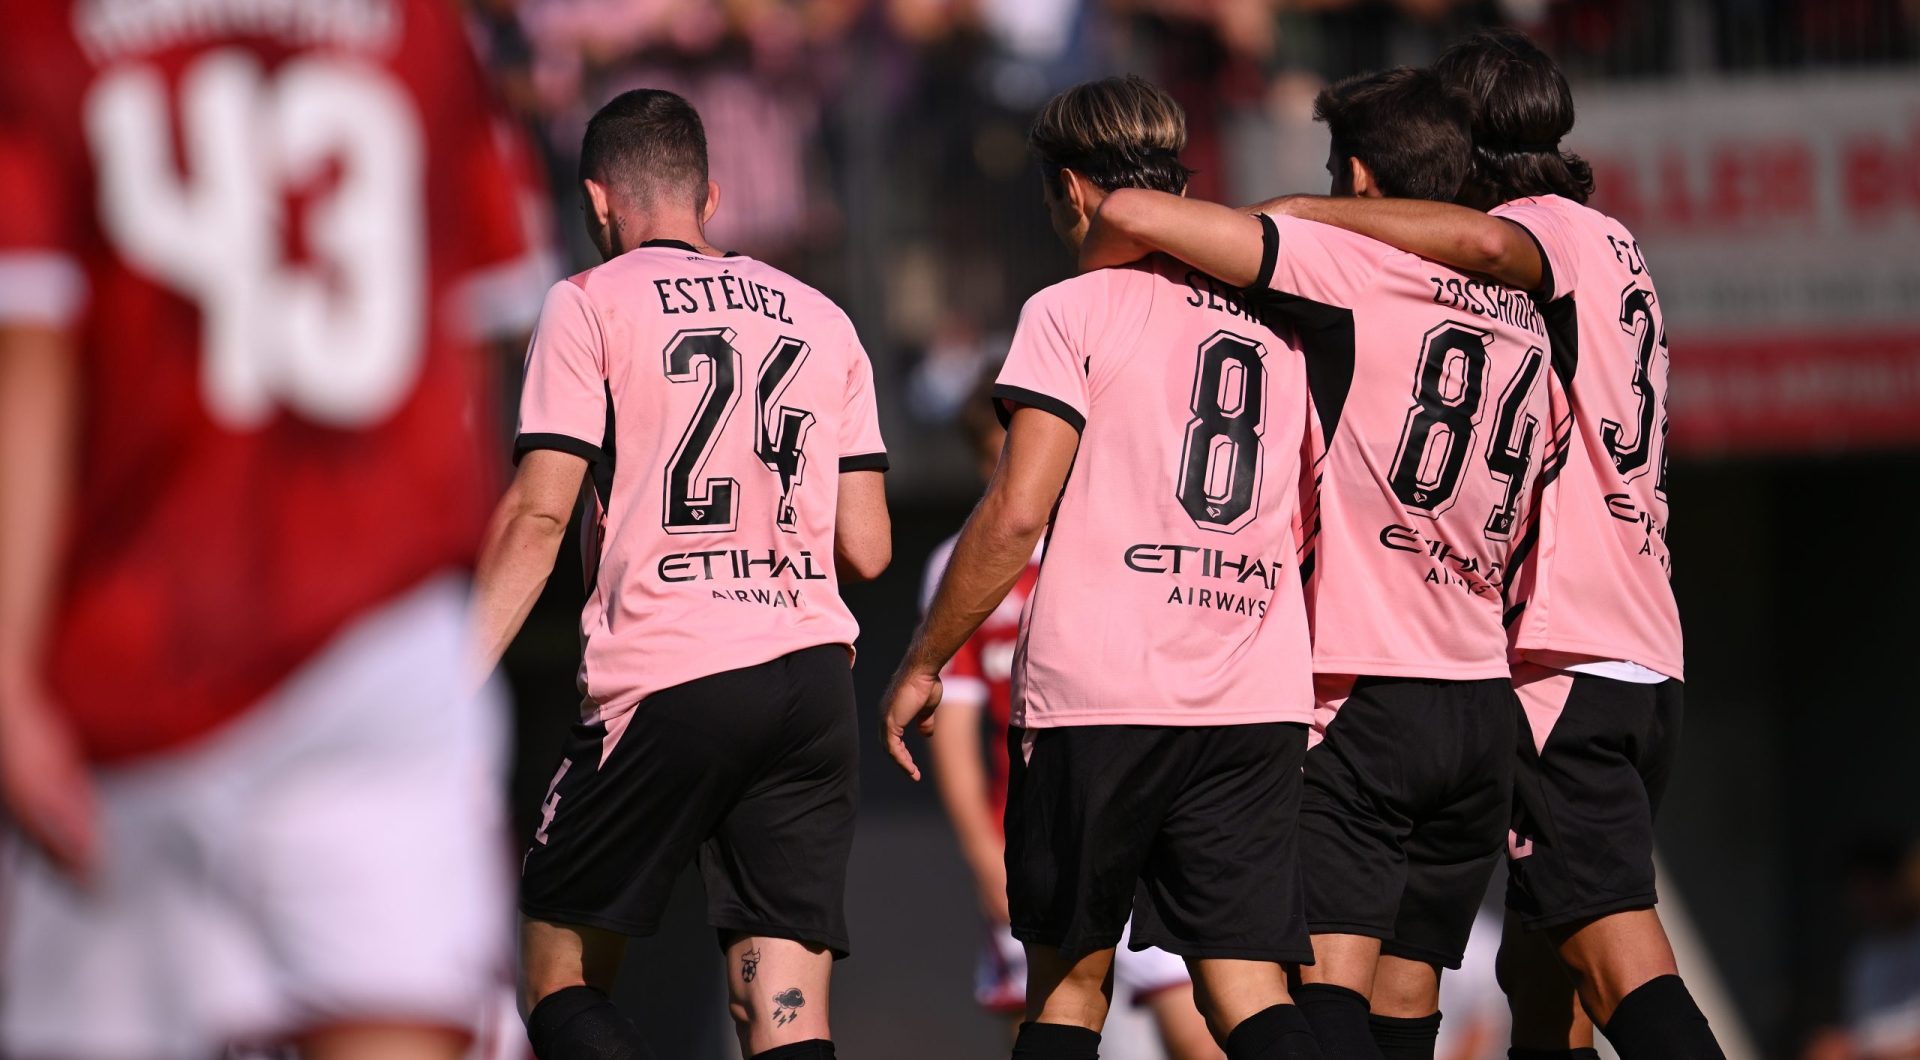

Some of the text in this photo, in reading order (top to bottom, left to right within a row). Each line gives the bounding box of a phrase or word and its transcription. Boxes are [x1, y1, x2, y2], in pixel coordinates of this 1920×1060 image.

[84, 47, 426, 430] 43
[653, 269, 793, 324] ESTÉVEZ
[1184, 270, 1263, 324] SEG
[662, 326, 816, 535] 24
[1176, 328, 1268, 536] 8
[1387, 319, 1543, 541] 84
[712, 589, 803, 608] AIRWAY
[1167, 586, 1267, 619] AIRWAYS
